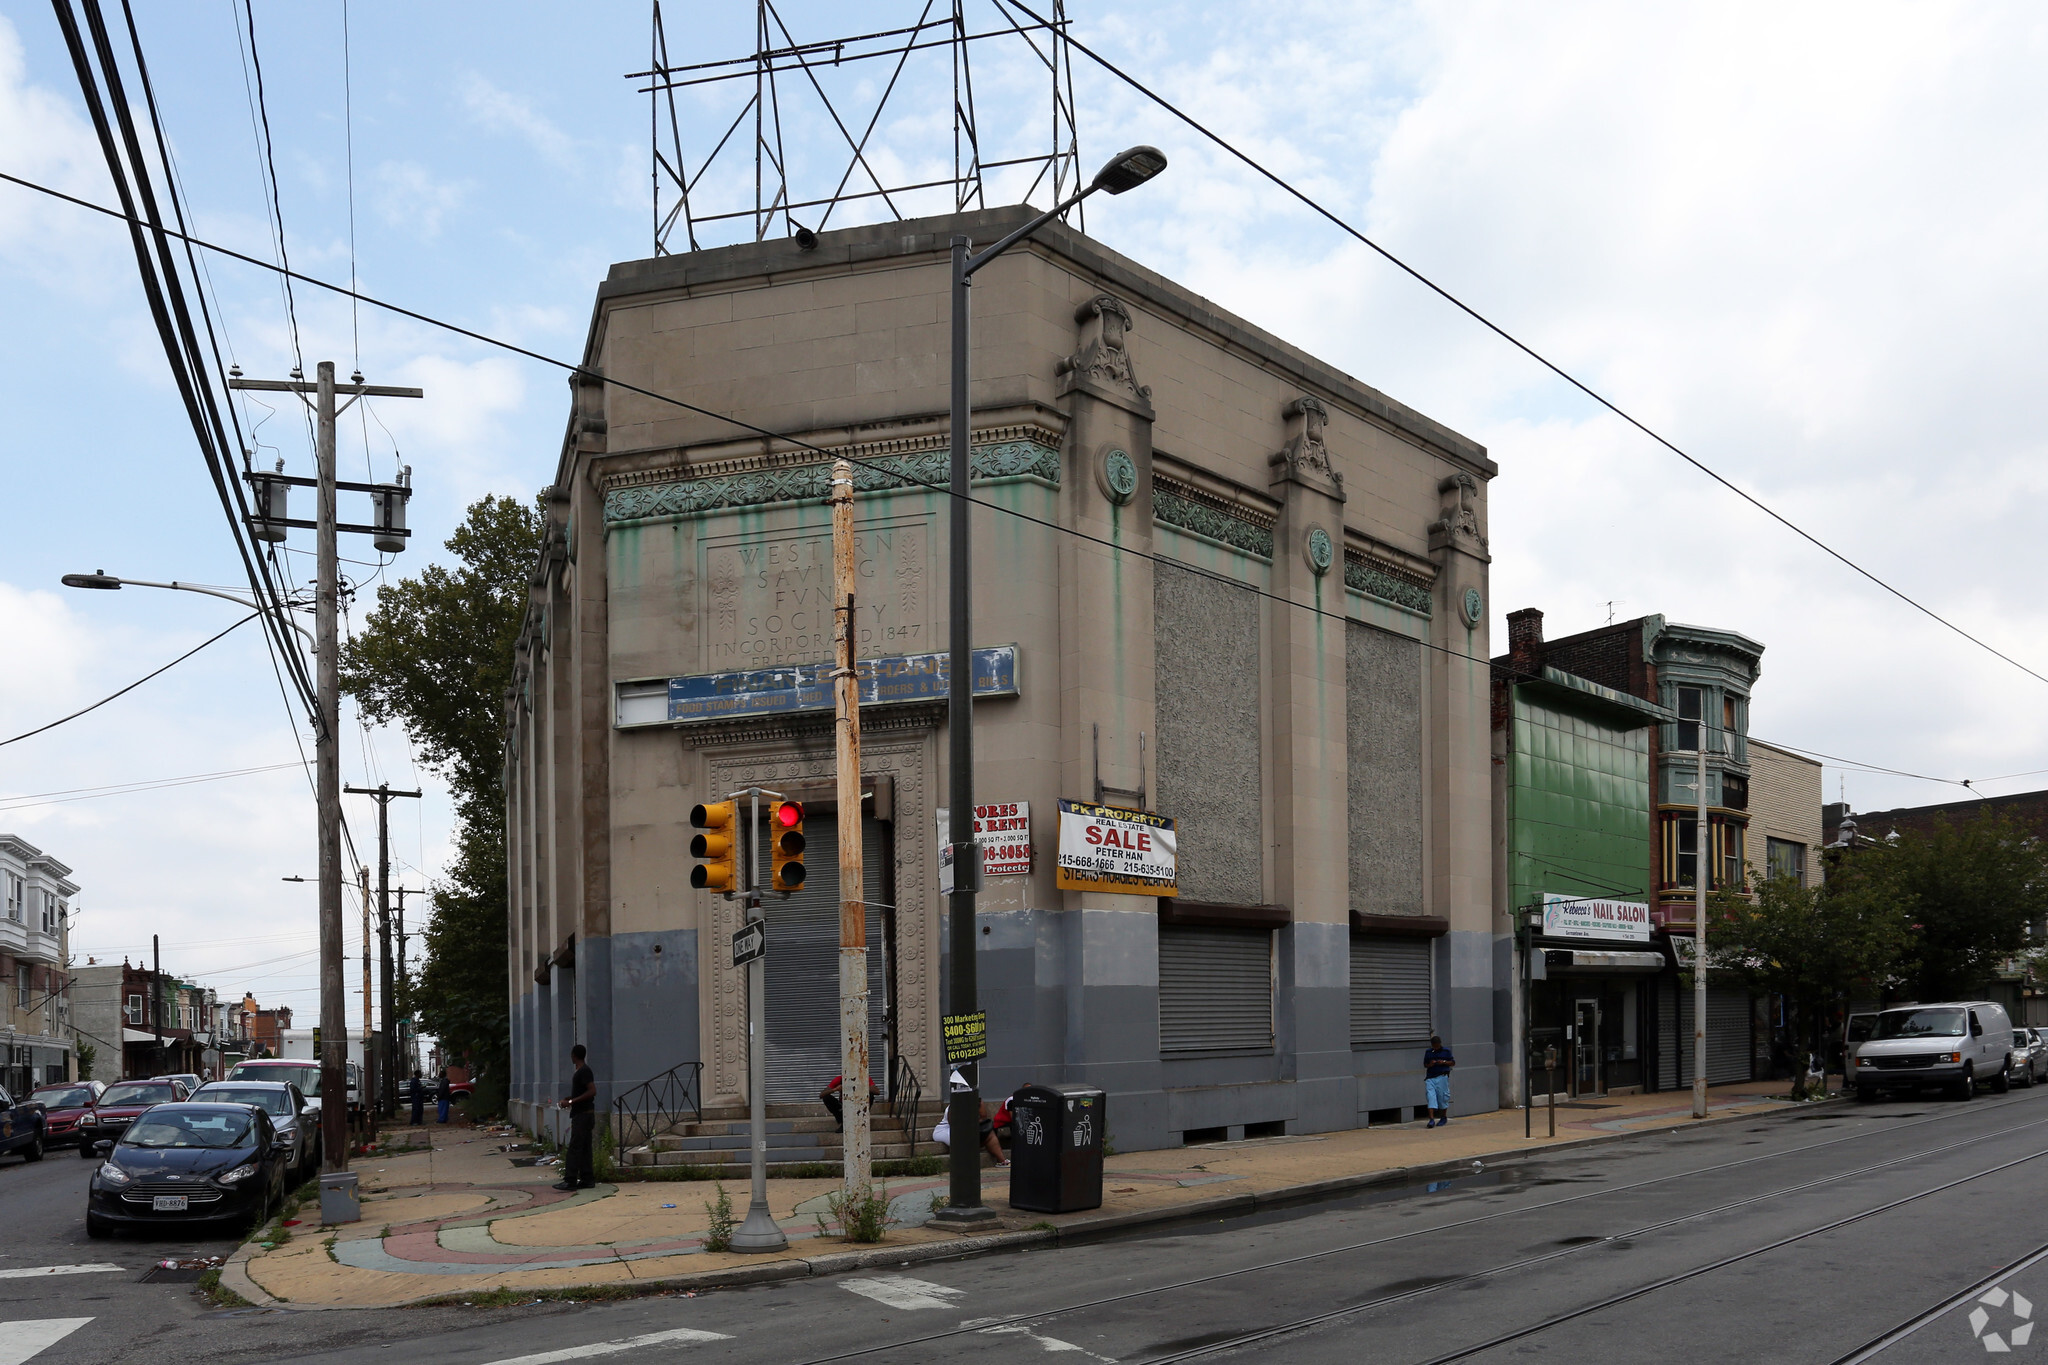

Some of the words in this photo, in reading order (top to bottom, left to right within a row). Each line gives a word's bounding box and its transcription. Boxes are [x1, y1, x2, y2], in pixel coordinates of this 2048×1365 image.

[737, 533, 892, 565] WESTRN
[757, 560, 875, 588] SAVIG
[747, 603, 887, 635] SOCITY
[714, 629, 872, 657] INCORPORAD
[880, 624, 921, 641] 1847
[676, 702, 703, 714] FOOD
[706, 699, 747, 712] STAMPS
[751, 695, 786, 707] ISSUED
[878, 682, 914, 697] RDERS
[978, 674, 1009, 688] BILLS
[973, 803, 1018, 819] ORES
[1071, 803, 1091, 816] PK
[1094, 807, 1166, 828] PROPERTY
[986, 817, 1027, 833] RENT
[1095, 818, 1116, 827] REAL
[1117, 820, 1145, 832] ESTATE
[1085, 825, 1151, 852] SALE
[1096, 847, 1124, 858] PETER
[1125, 851, 1143, 861] HAN
[1123, 862, 1174, 878] 215-635-5100
[1562, 900, 1591, 916] Rebecca's
[1593, 902, 1614, 921] NAIL
[1617, 904, 1646, 923] SALON
[735, 940, 744, 956] ONE
[745, 935, 754, 951] WAY
[943, 1016, 954, 1025] 300
